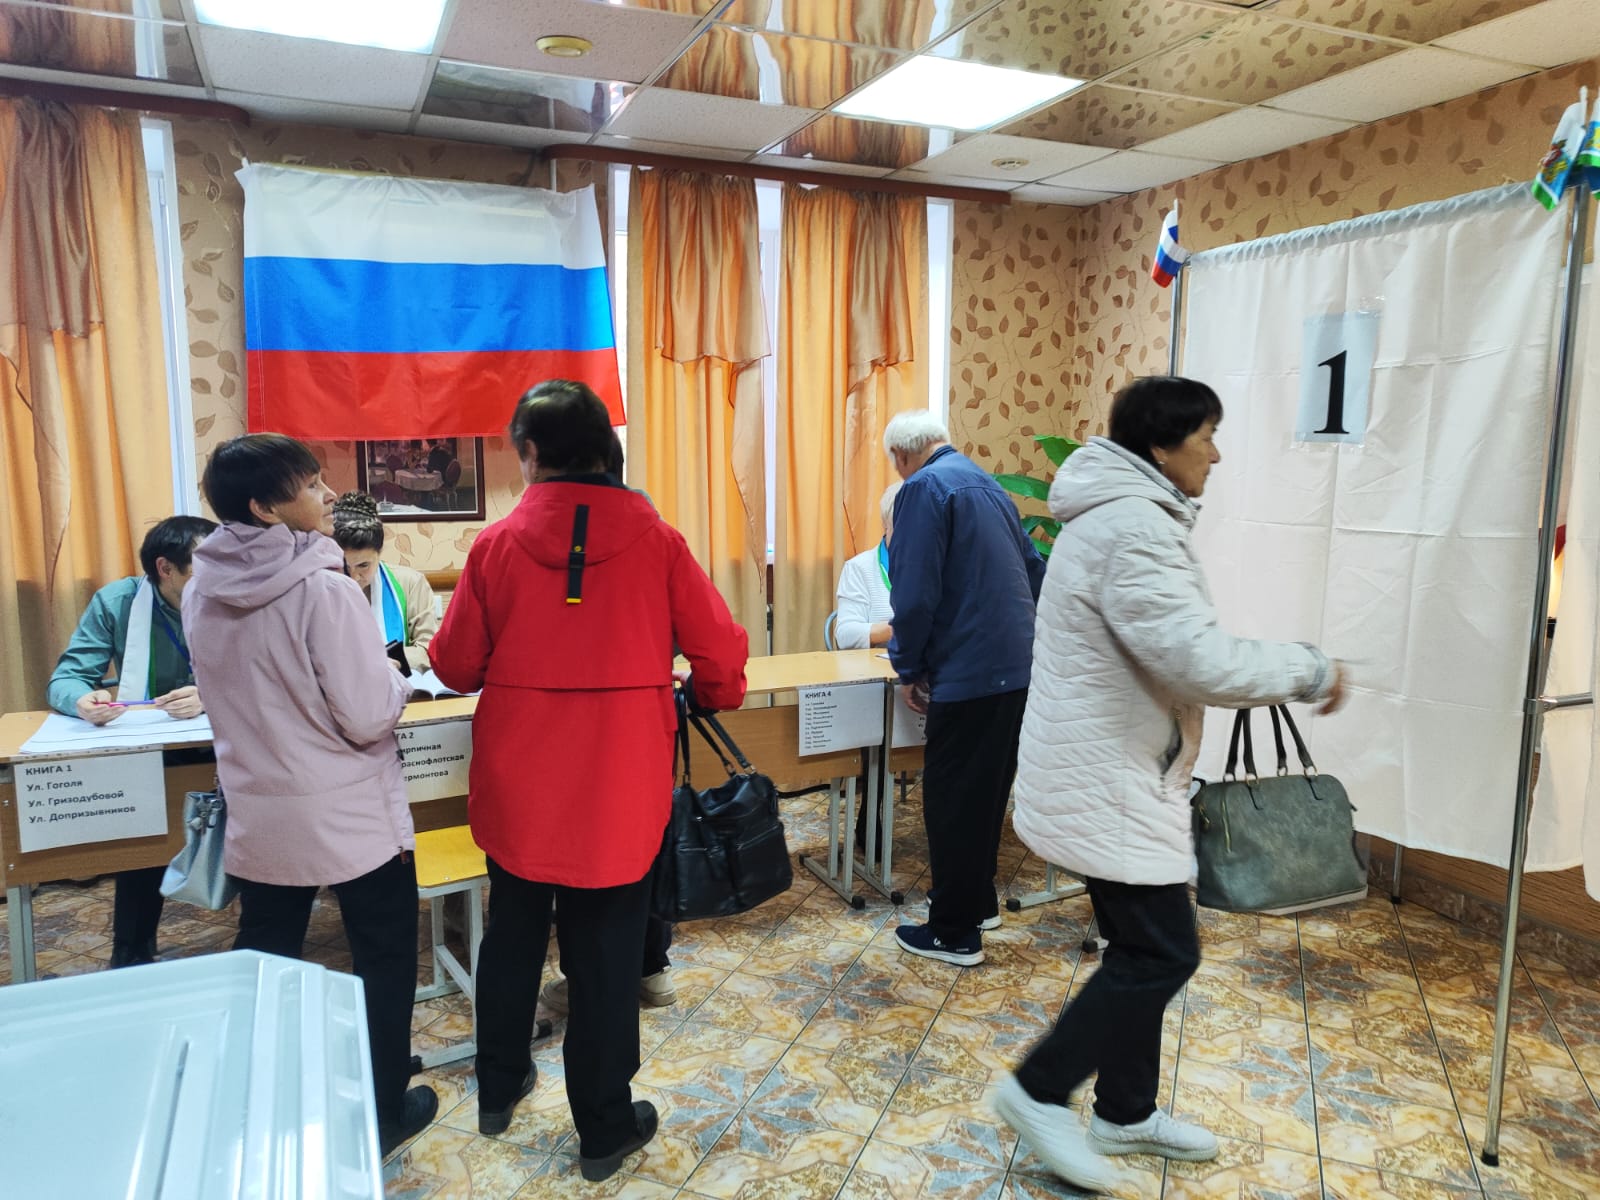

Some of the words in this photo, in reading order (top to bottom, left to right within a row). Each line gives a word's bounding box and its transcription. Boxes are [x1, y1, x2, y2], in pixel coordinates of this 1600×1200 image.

[1313, 350, 1350, 434] 1
[805, 691, 826, 699] КНИГА
[408, 731, 415, 739] 2
[401, 743, 442, 755] ирпичная
[401, 754, 465, 769] раснофлотская
[25, 765, 63, 776] КНИГА
[66, 764, 73, 772] 1
[404, 770, 449, 782] ермонтова
[26, 783, 44, 792] Ул.
[46, 780, 83, 790] Гоголя
[28, 800, 45, 808] Ул.
[48, 790, 125, 807] Гризодубовой
[29, 815, 47, 824] Ул.
[49, 805, 136, 823] Допризывников
